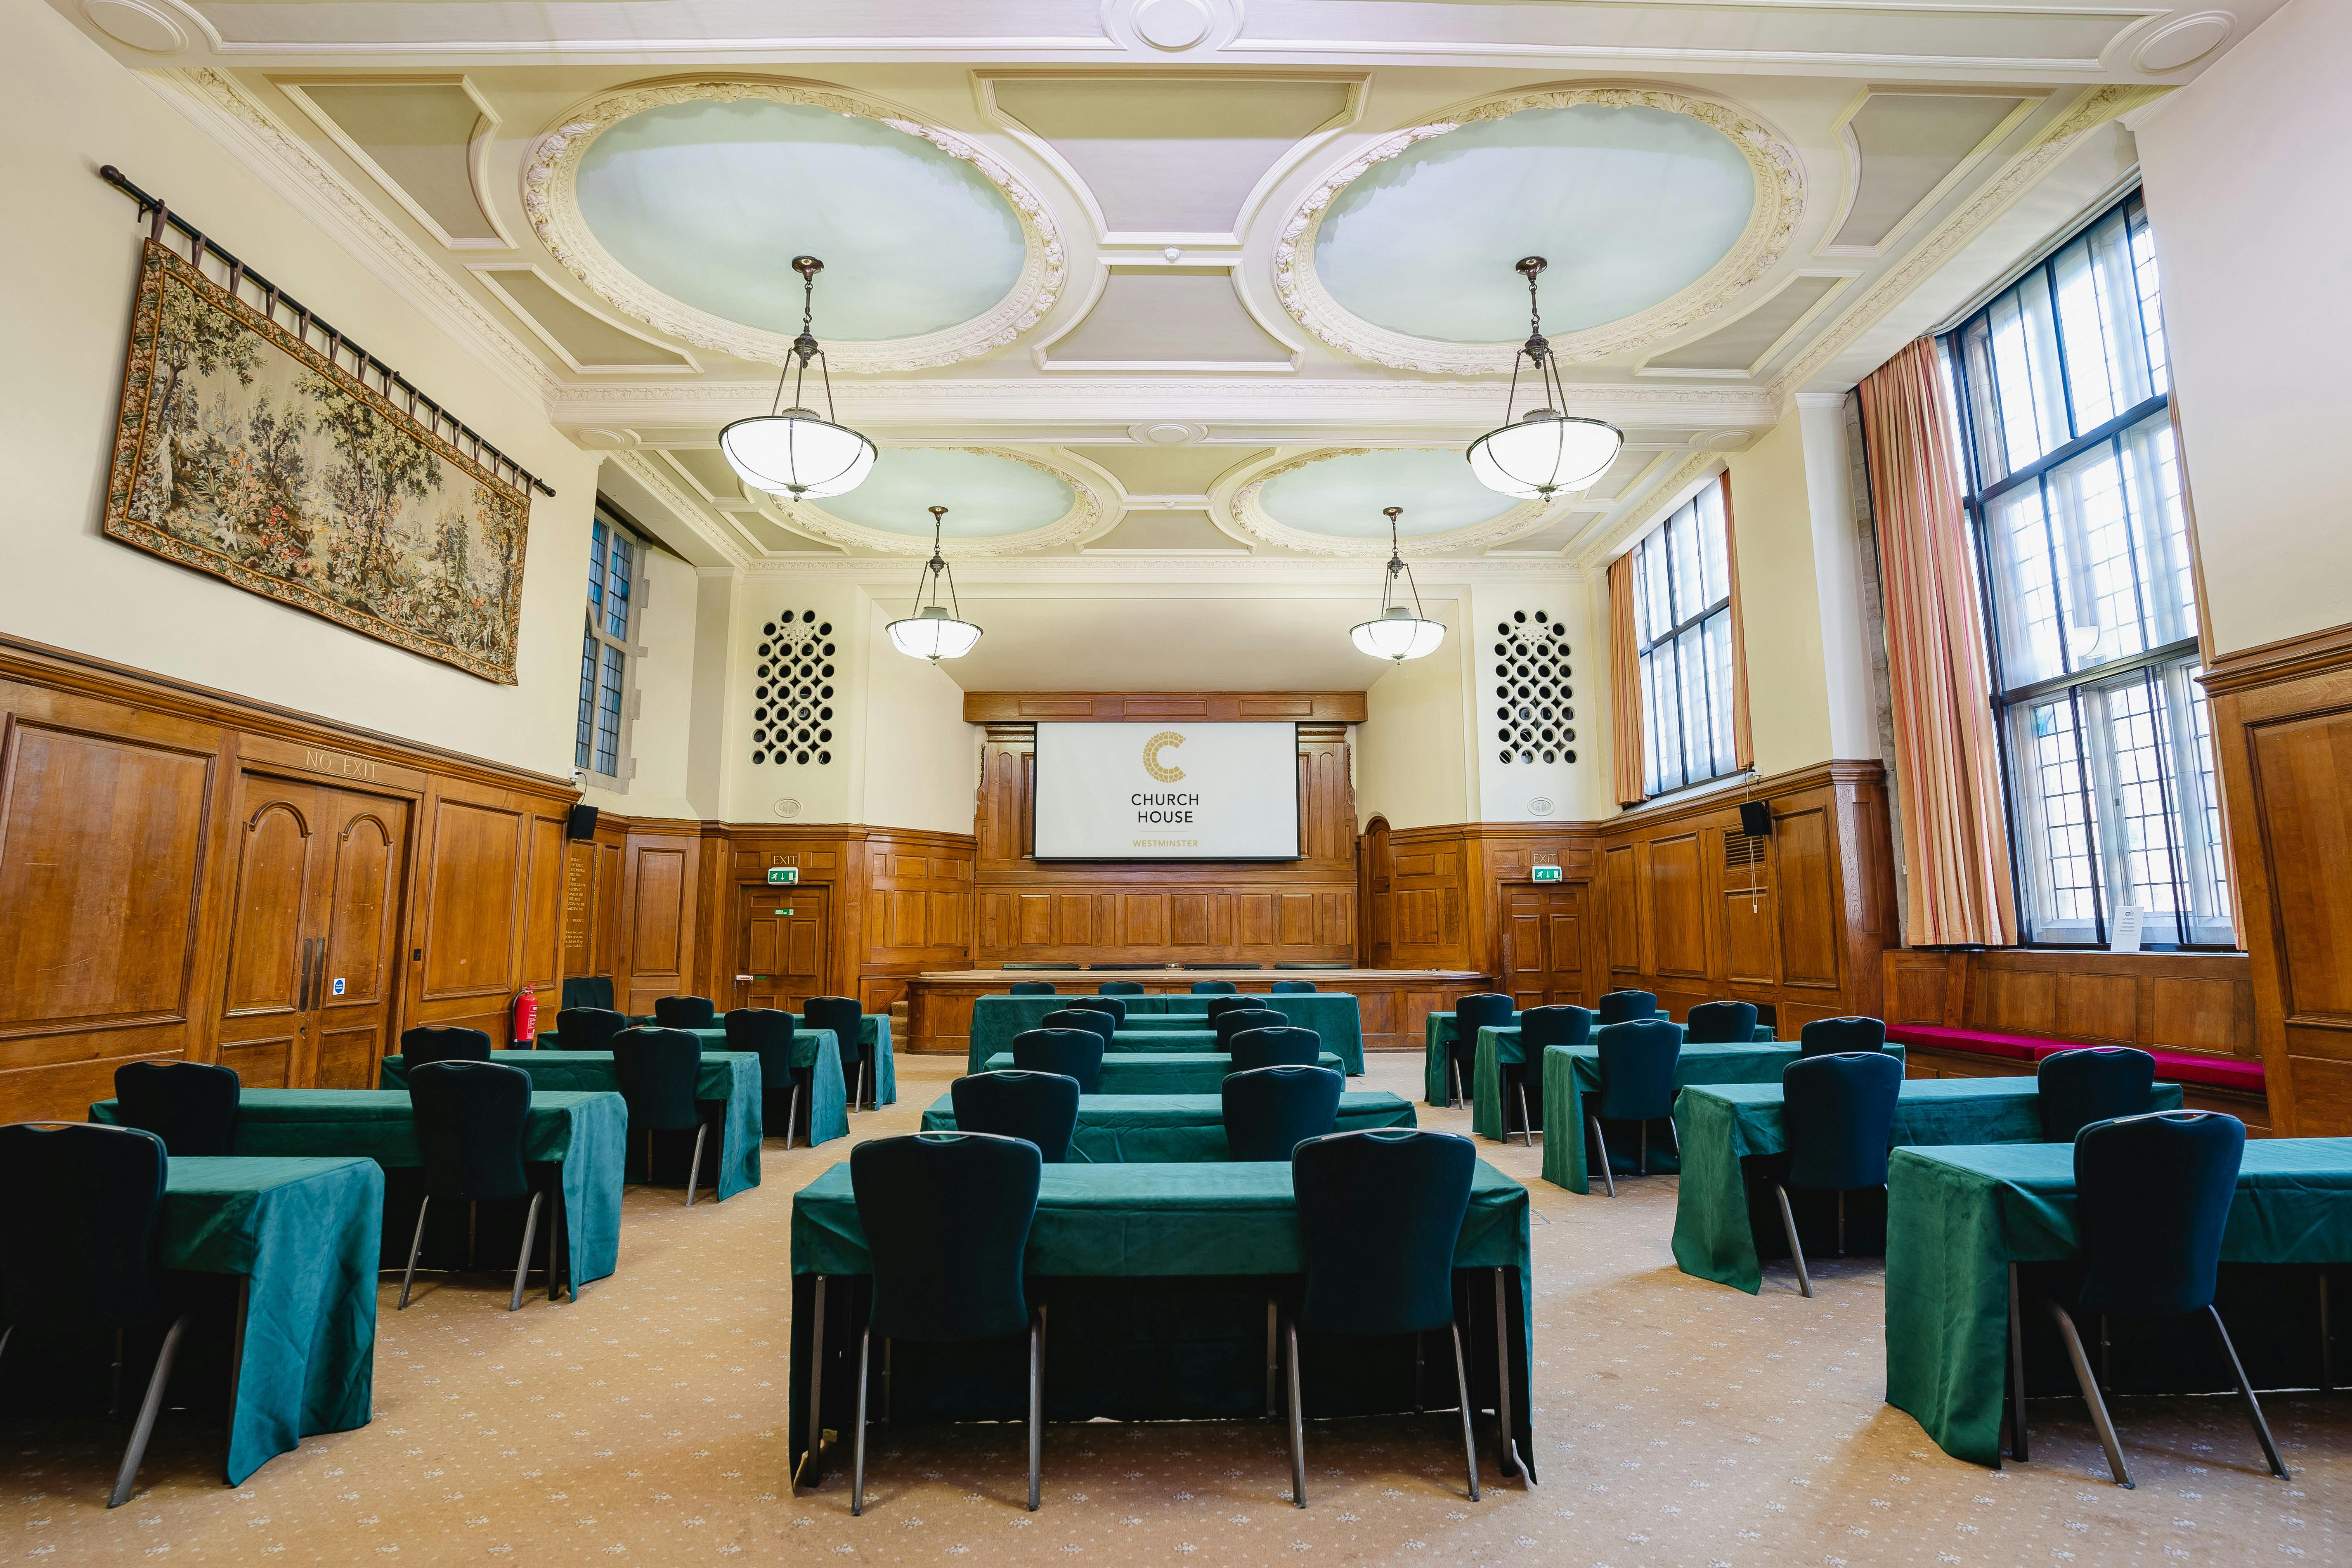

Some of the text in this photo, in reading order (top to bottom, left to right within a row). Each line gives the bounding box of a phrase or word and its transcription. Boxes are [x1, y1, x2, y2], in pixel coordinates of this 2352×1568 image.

[307, 750, 377, 779] NO EXIT
[1131, 794, 1199, 806] CHURCH
[1138, 811, 1193, 823] HOUSE
[773, 855, 797, 865] EXIT
[1533, 854, 1556, 863] EXIT
